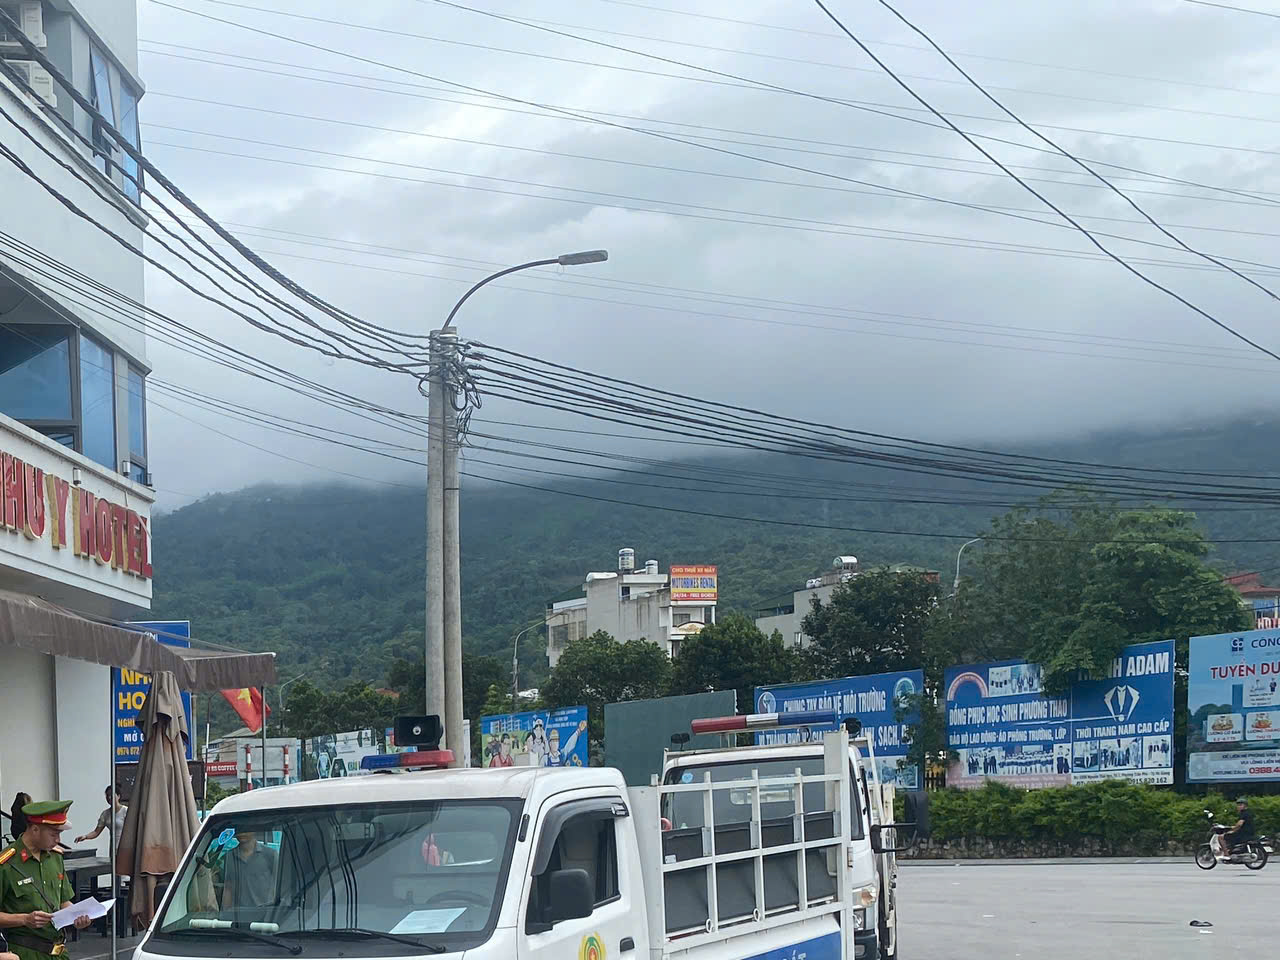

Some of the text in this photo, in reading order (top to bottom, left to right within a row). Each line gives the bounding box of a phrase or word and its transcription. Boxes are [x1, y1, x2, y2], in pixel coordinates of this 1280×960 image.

[71, 485, 153, 580] HOTEL
[1125, 651, 1170, 678] ADAM
[118, 691, 147, 710] HO
[1001, 703, 1018, 722] SINH
[1093, 725, 1117, 737] TRANG
[1118, 723, 1136, 735] NAM
[1137, 722, 1153, 734] CAO
